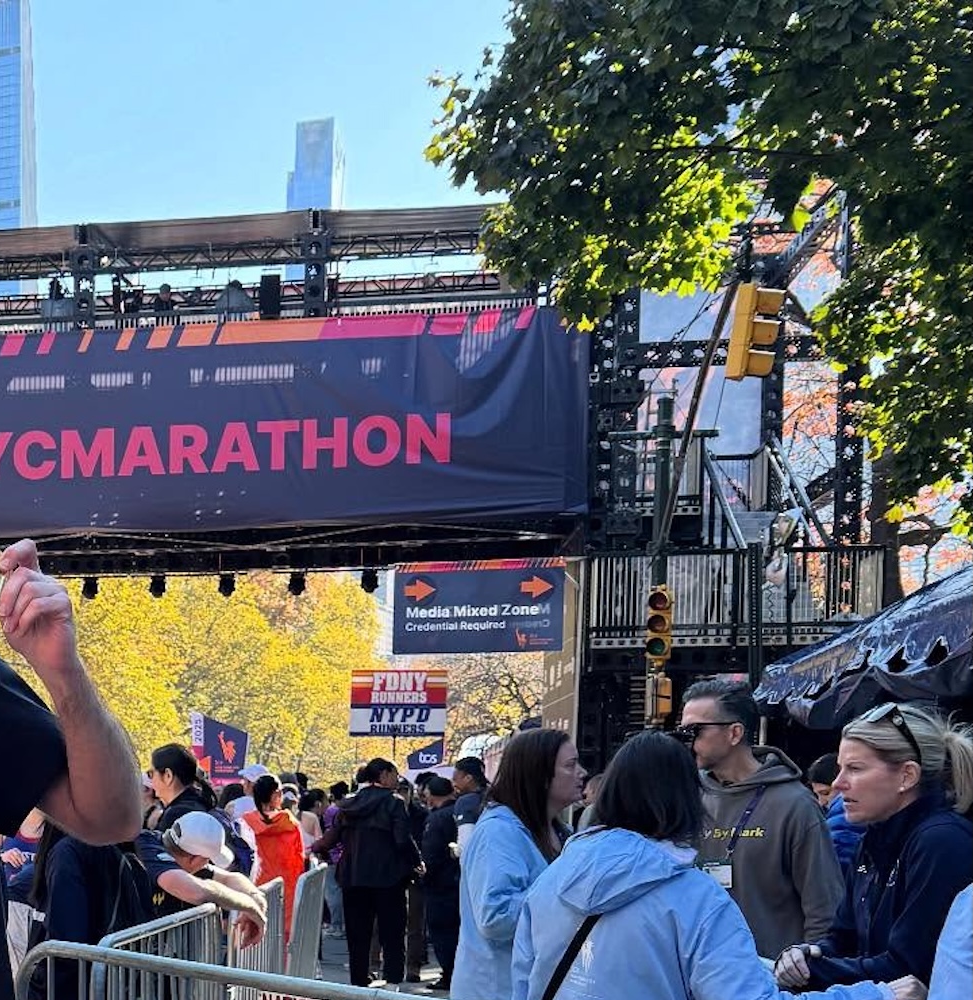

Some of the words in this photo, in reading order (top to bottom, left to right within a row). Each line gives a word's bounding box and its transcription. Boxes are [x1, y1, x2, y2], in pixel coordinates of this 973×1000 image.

[405, 606, 450, 619] Media
[453, 604, 498, 617] Mixed
[501, 603, 540, 616] Zone
[405, 621, 458, 632] Credential
[460, 620, 506, 632] Required
[372, 672, 428, 691] FDNY
[370, 691, 427, 704] RUNNERS
[369, 706, 431, 722] NYPD
[370, 723, 425, 734] RUNNERS
